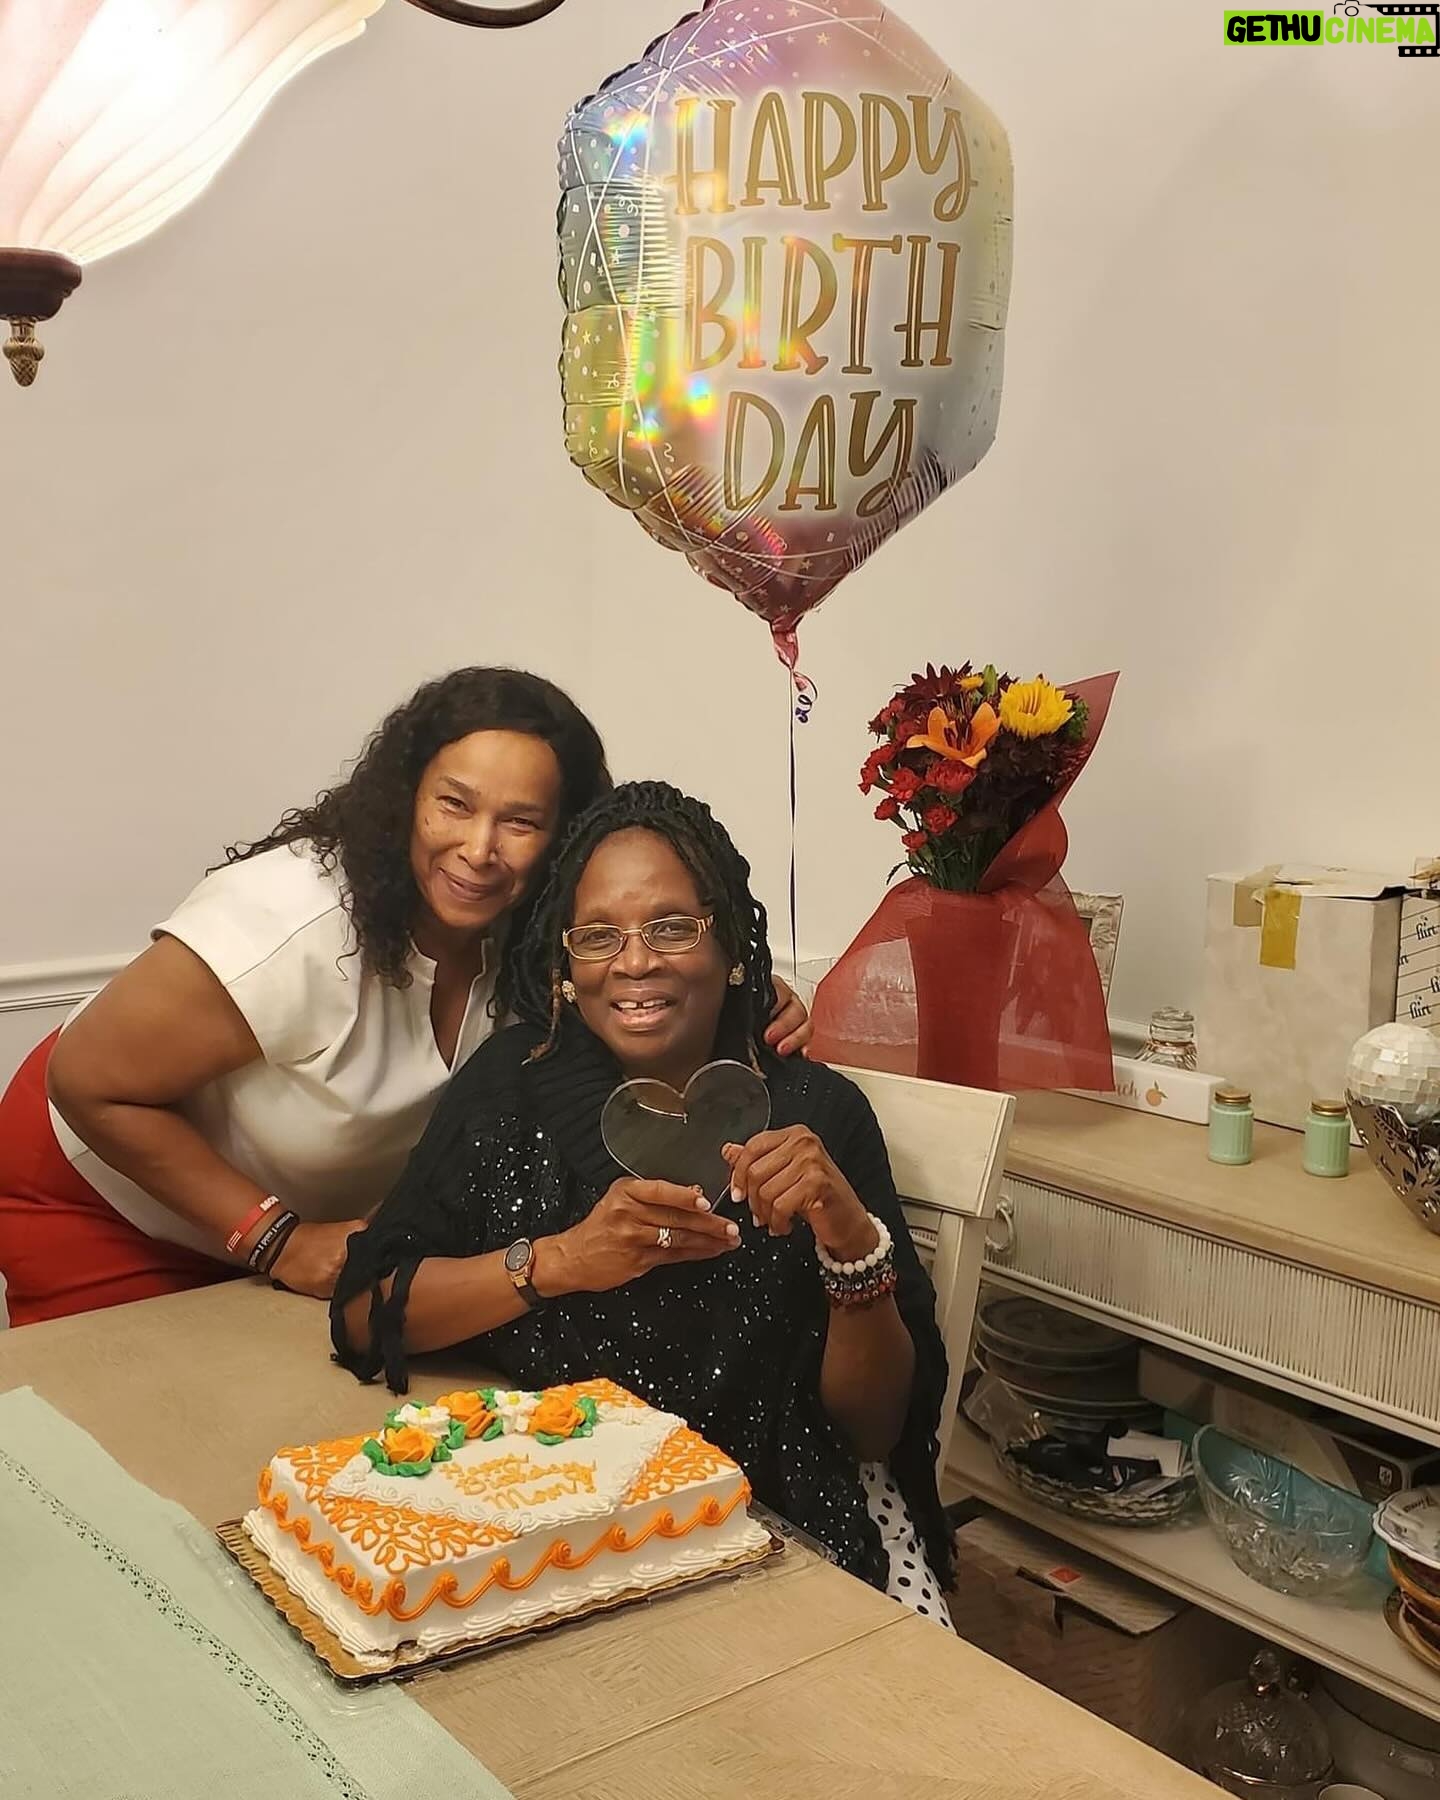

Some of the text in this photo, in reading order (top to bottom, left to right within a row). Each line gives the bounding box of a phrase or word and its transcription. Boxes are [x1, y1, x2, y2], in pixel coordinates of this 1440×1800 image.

[664, 91, 978, 222] HAPPY
[684, 234, 961, 375] BIRTH
[724, 391, 918, 518] DAY
